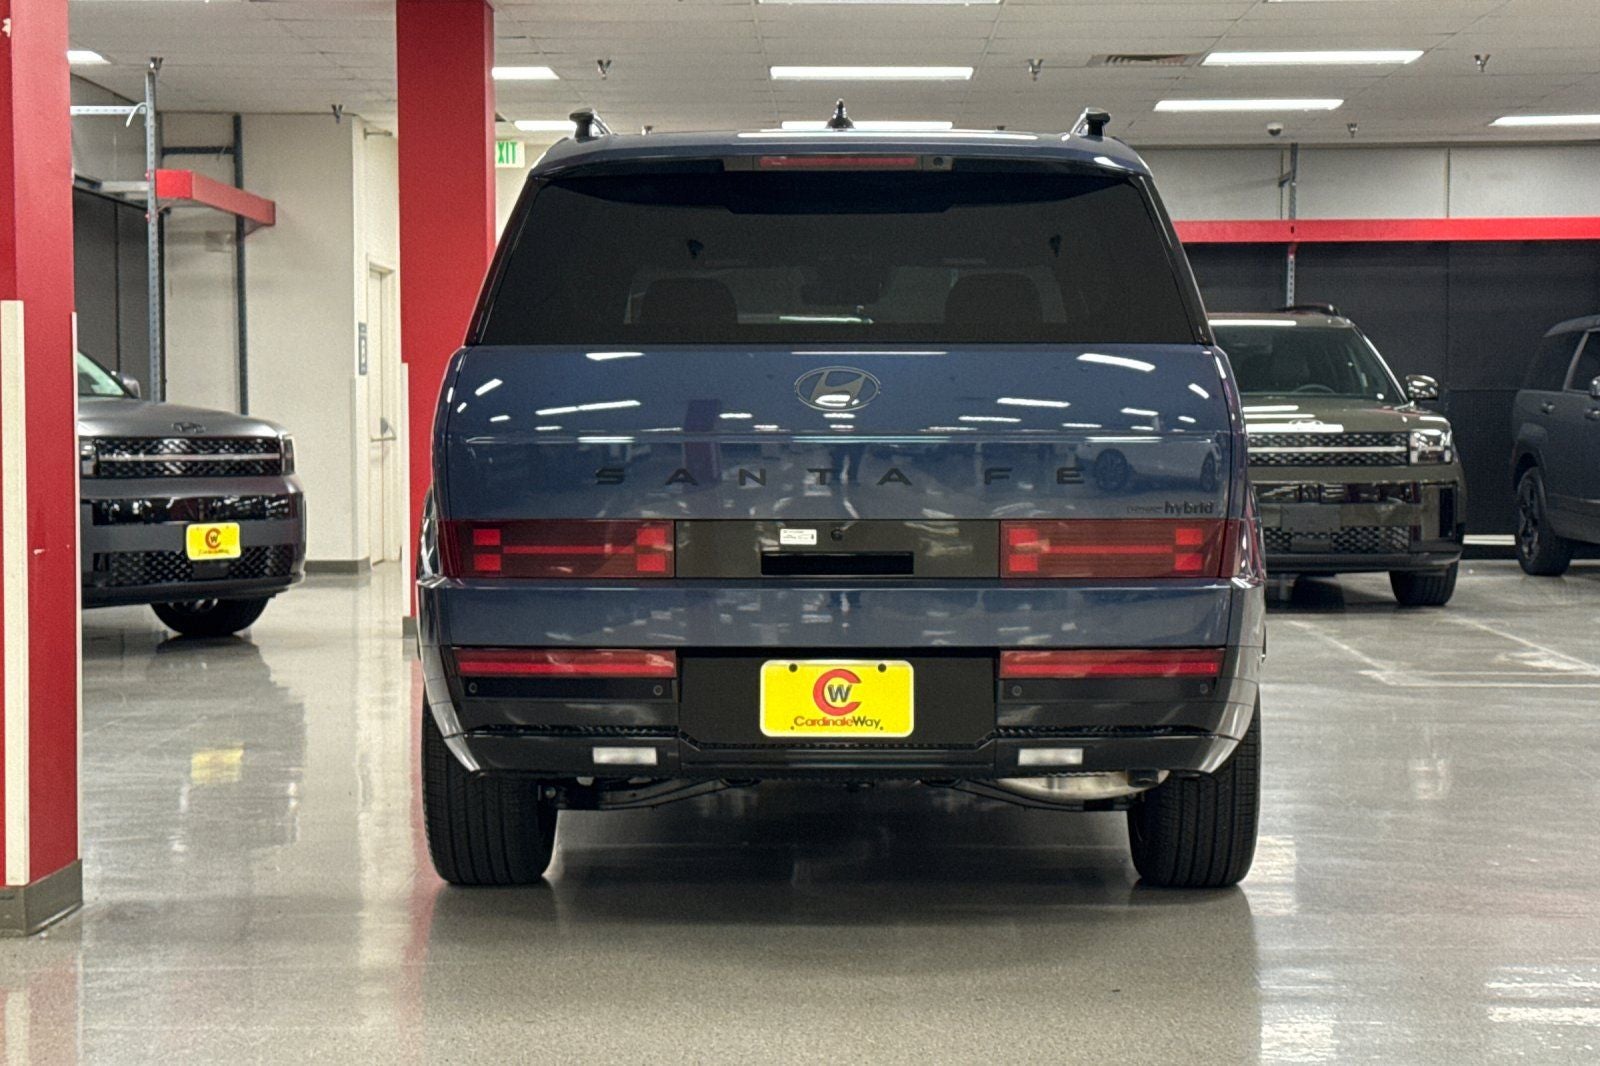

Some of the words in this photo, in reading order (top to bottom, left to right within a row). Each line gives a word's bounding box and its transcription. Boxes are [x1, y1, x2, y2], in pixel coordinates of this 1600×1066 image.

[497, 141, 518, 164] XIT
[594, 467, 913, 486] SANTA
[983, 466, 1086, 485] FE
[1164, 500, 1215, 515] hybrid
[793, 716, 881, 729] CardinaleWay
